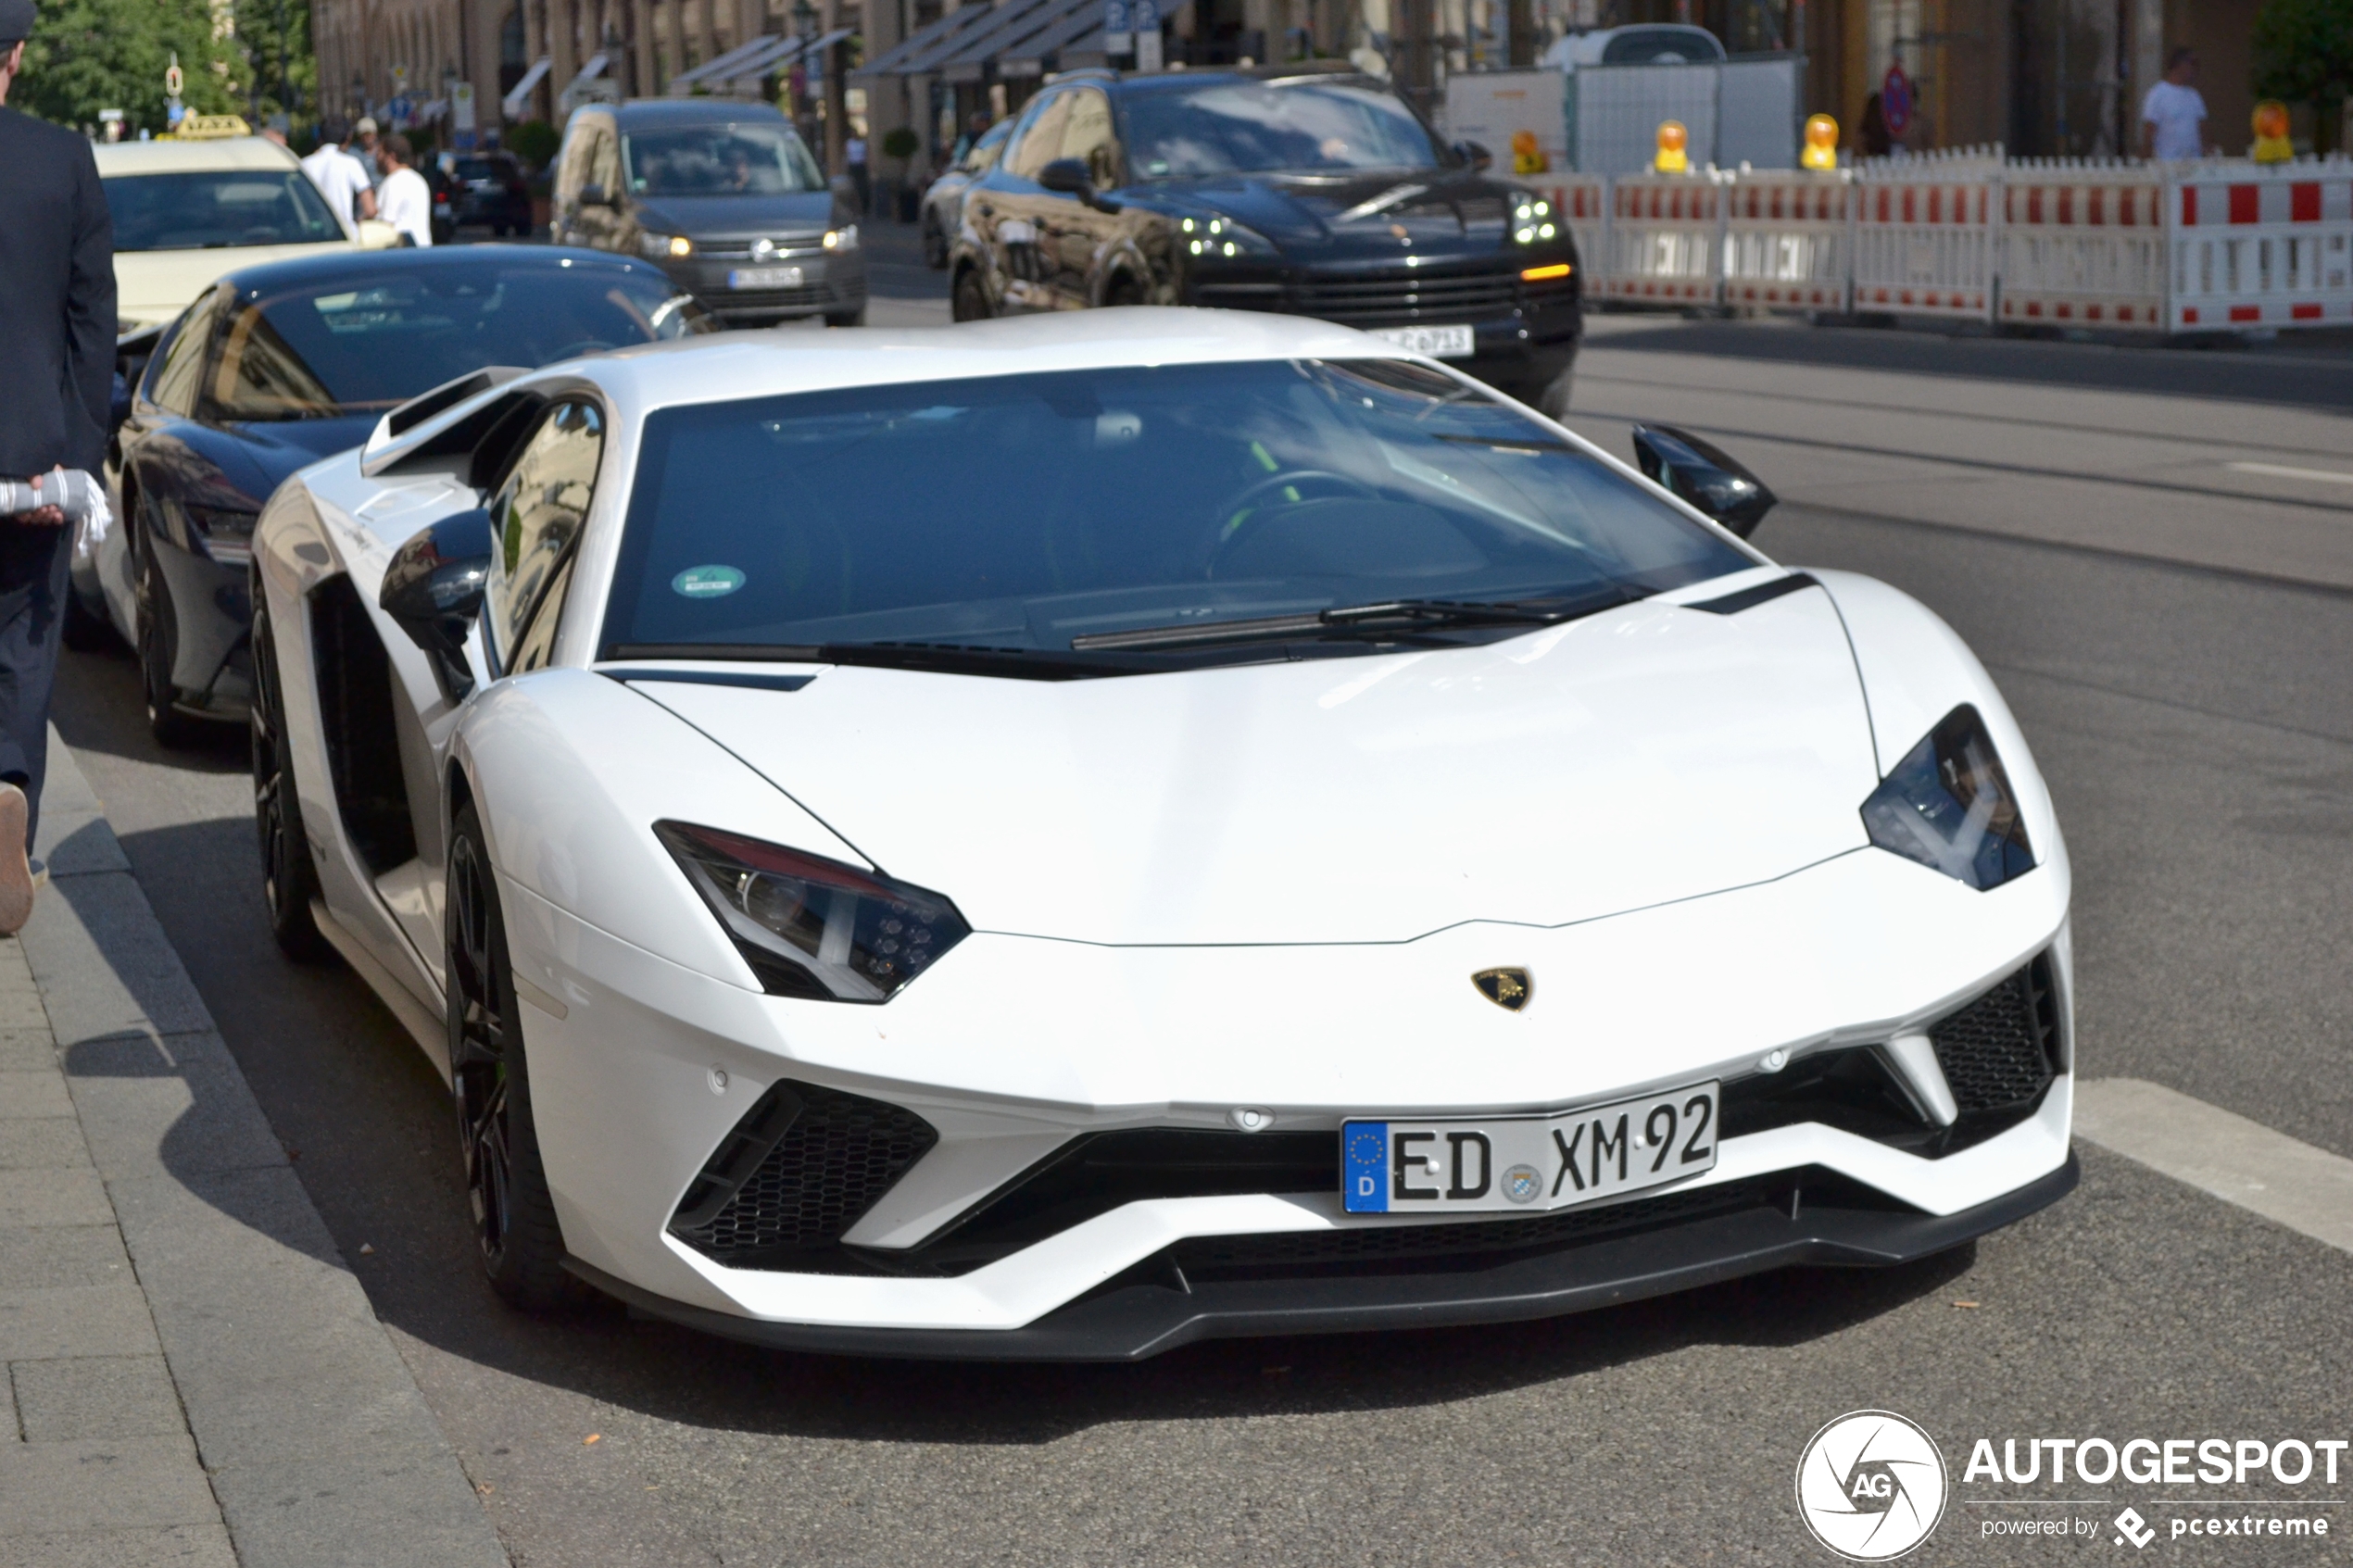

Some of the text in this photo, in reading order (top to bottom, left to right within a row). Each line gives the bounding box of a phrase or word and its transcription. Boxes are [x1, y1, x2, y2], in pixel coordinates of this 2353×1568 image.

[186, 117, 237, 131] TAXI
[1393, 1132, 1491, 1200] ED
[1359, 1176, 1375, 1197] D
